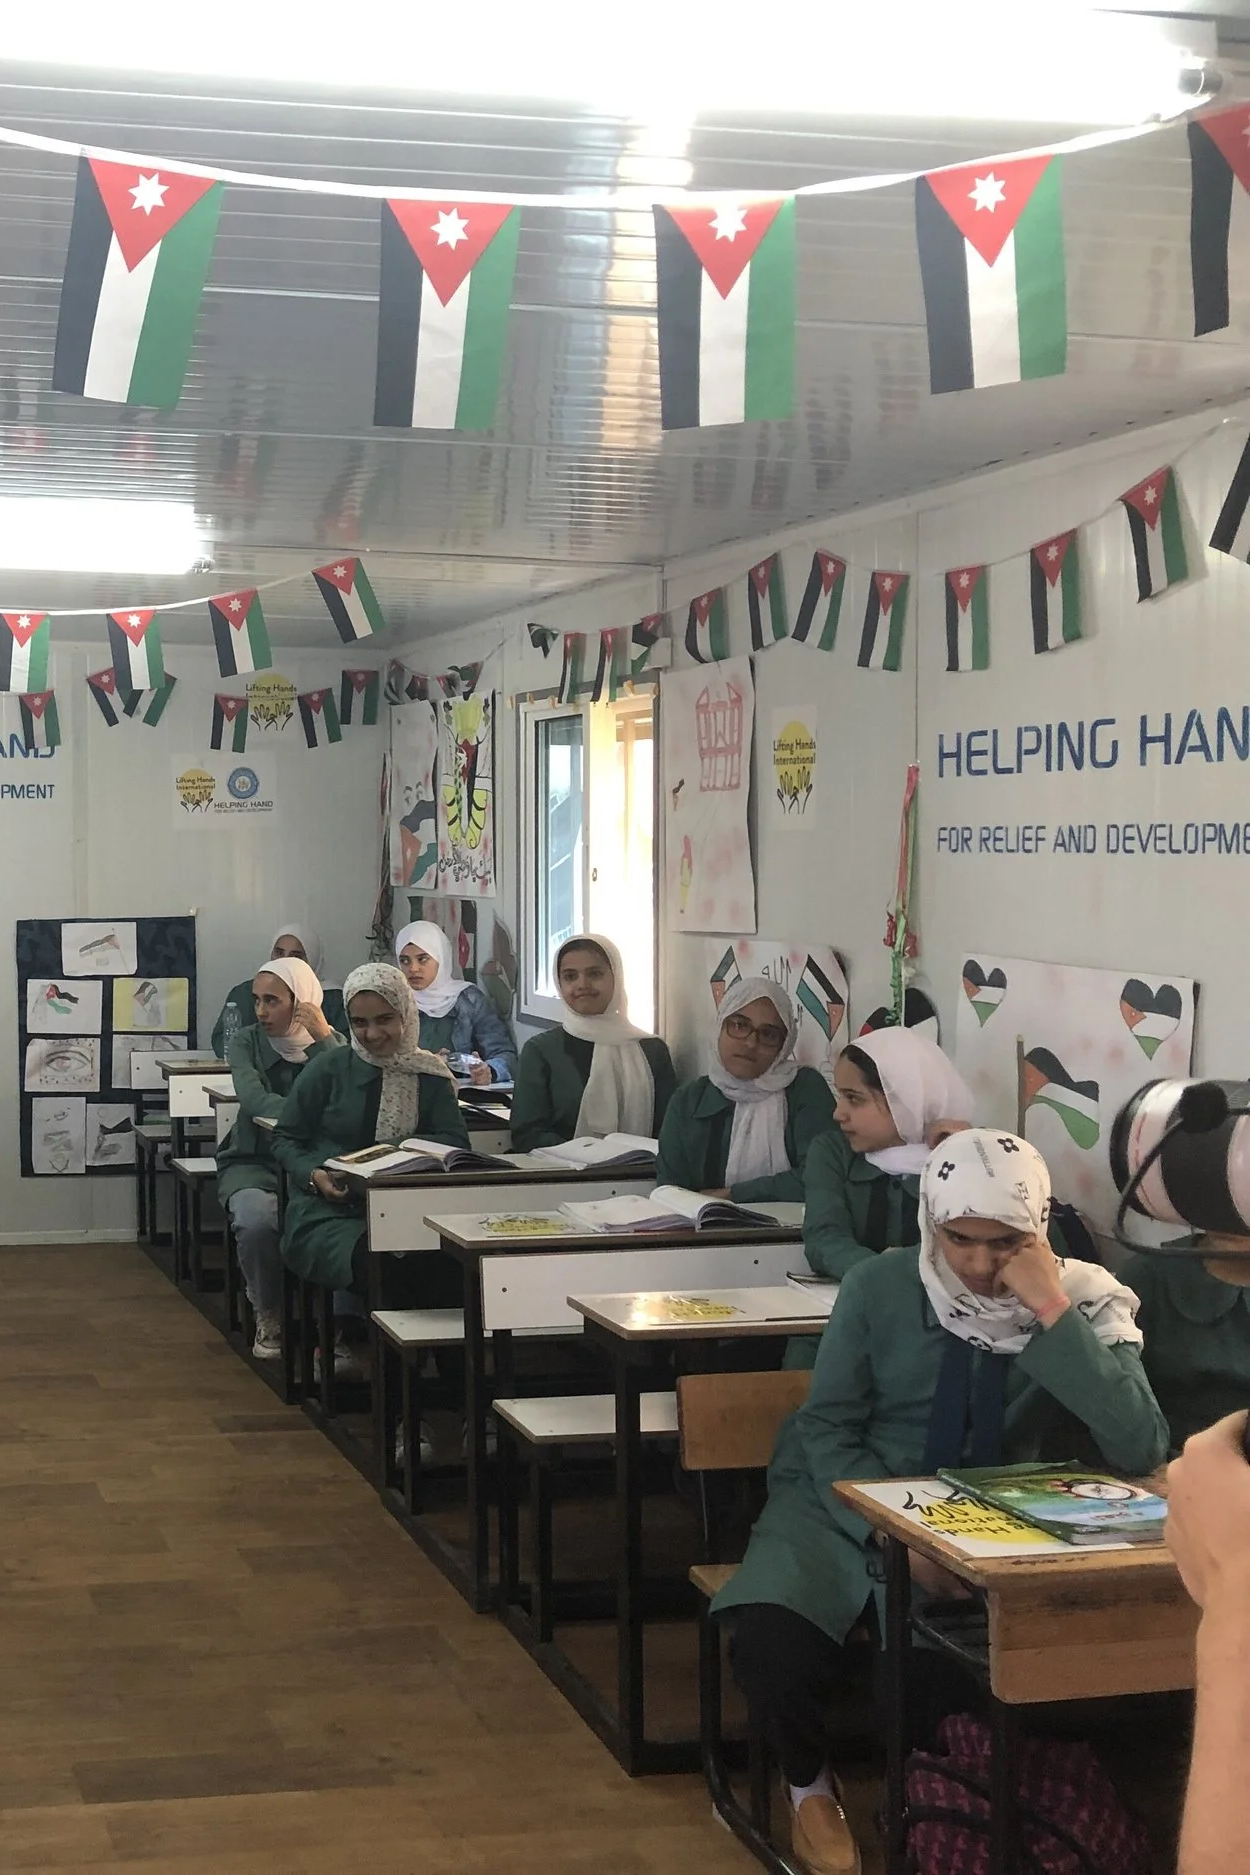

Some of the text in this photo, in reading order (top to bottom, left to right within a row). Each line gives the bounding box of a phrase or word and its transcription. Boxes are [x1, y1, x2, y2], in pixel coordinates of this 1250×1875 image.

[245, 683, 298, 695] Lifting Hands
[773, 738, 816, 755] Lifting Hands
[938, 706, 1250, 778] HELPING HAN
[773, 753, 816, 765] International
[214, 800, 273, 809] HELPING HAND
[937, 826, 973, 854] FOR
[979, 825, 1047, 854] RELIEF
[1053, 824, 1097, 853] AND
[933, 1526, 1010, 1537] Hands
